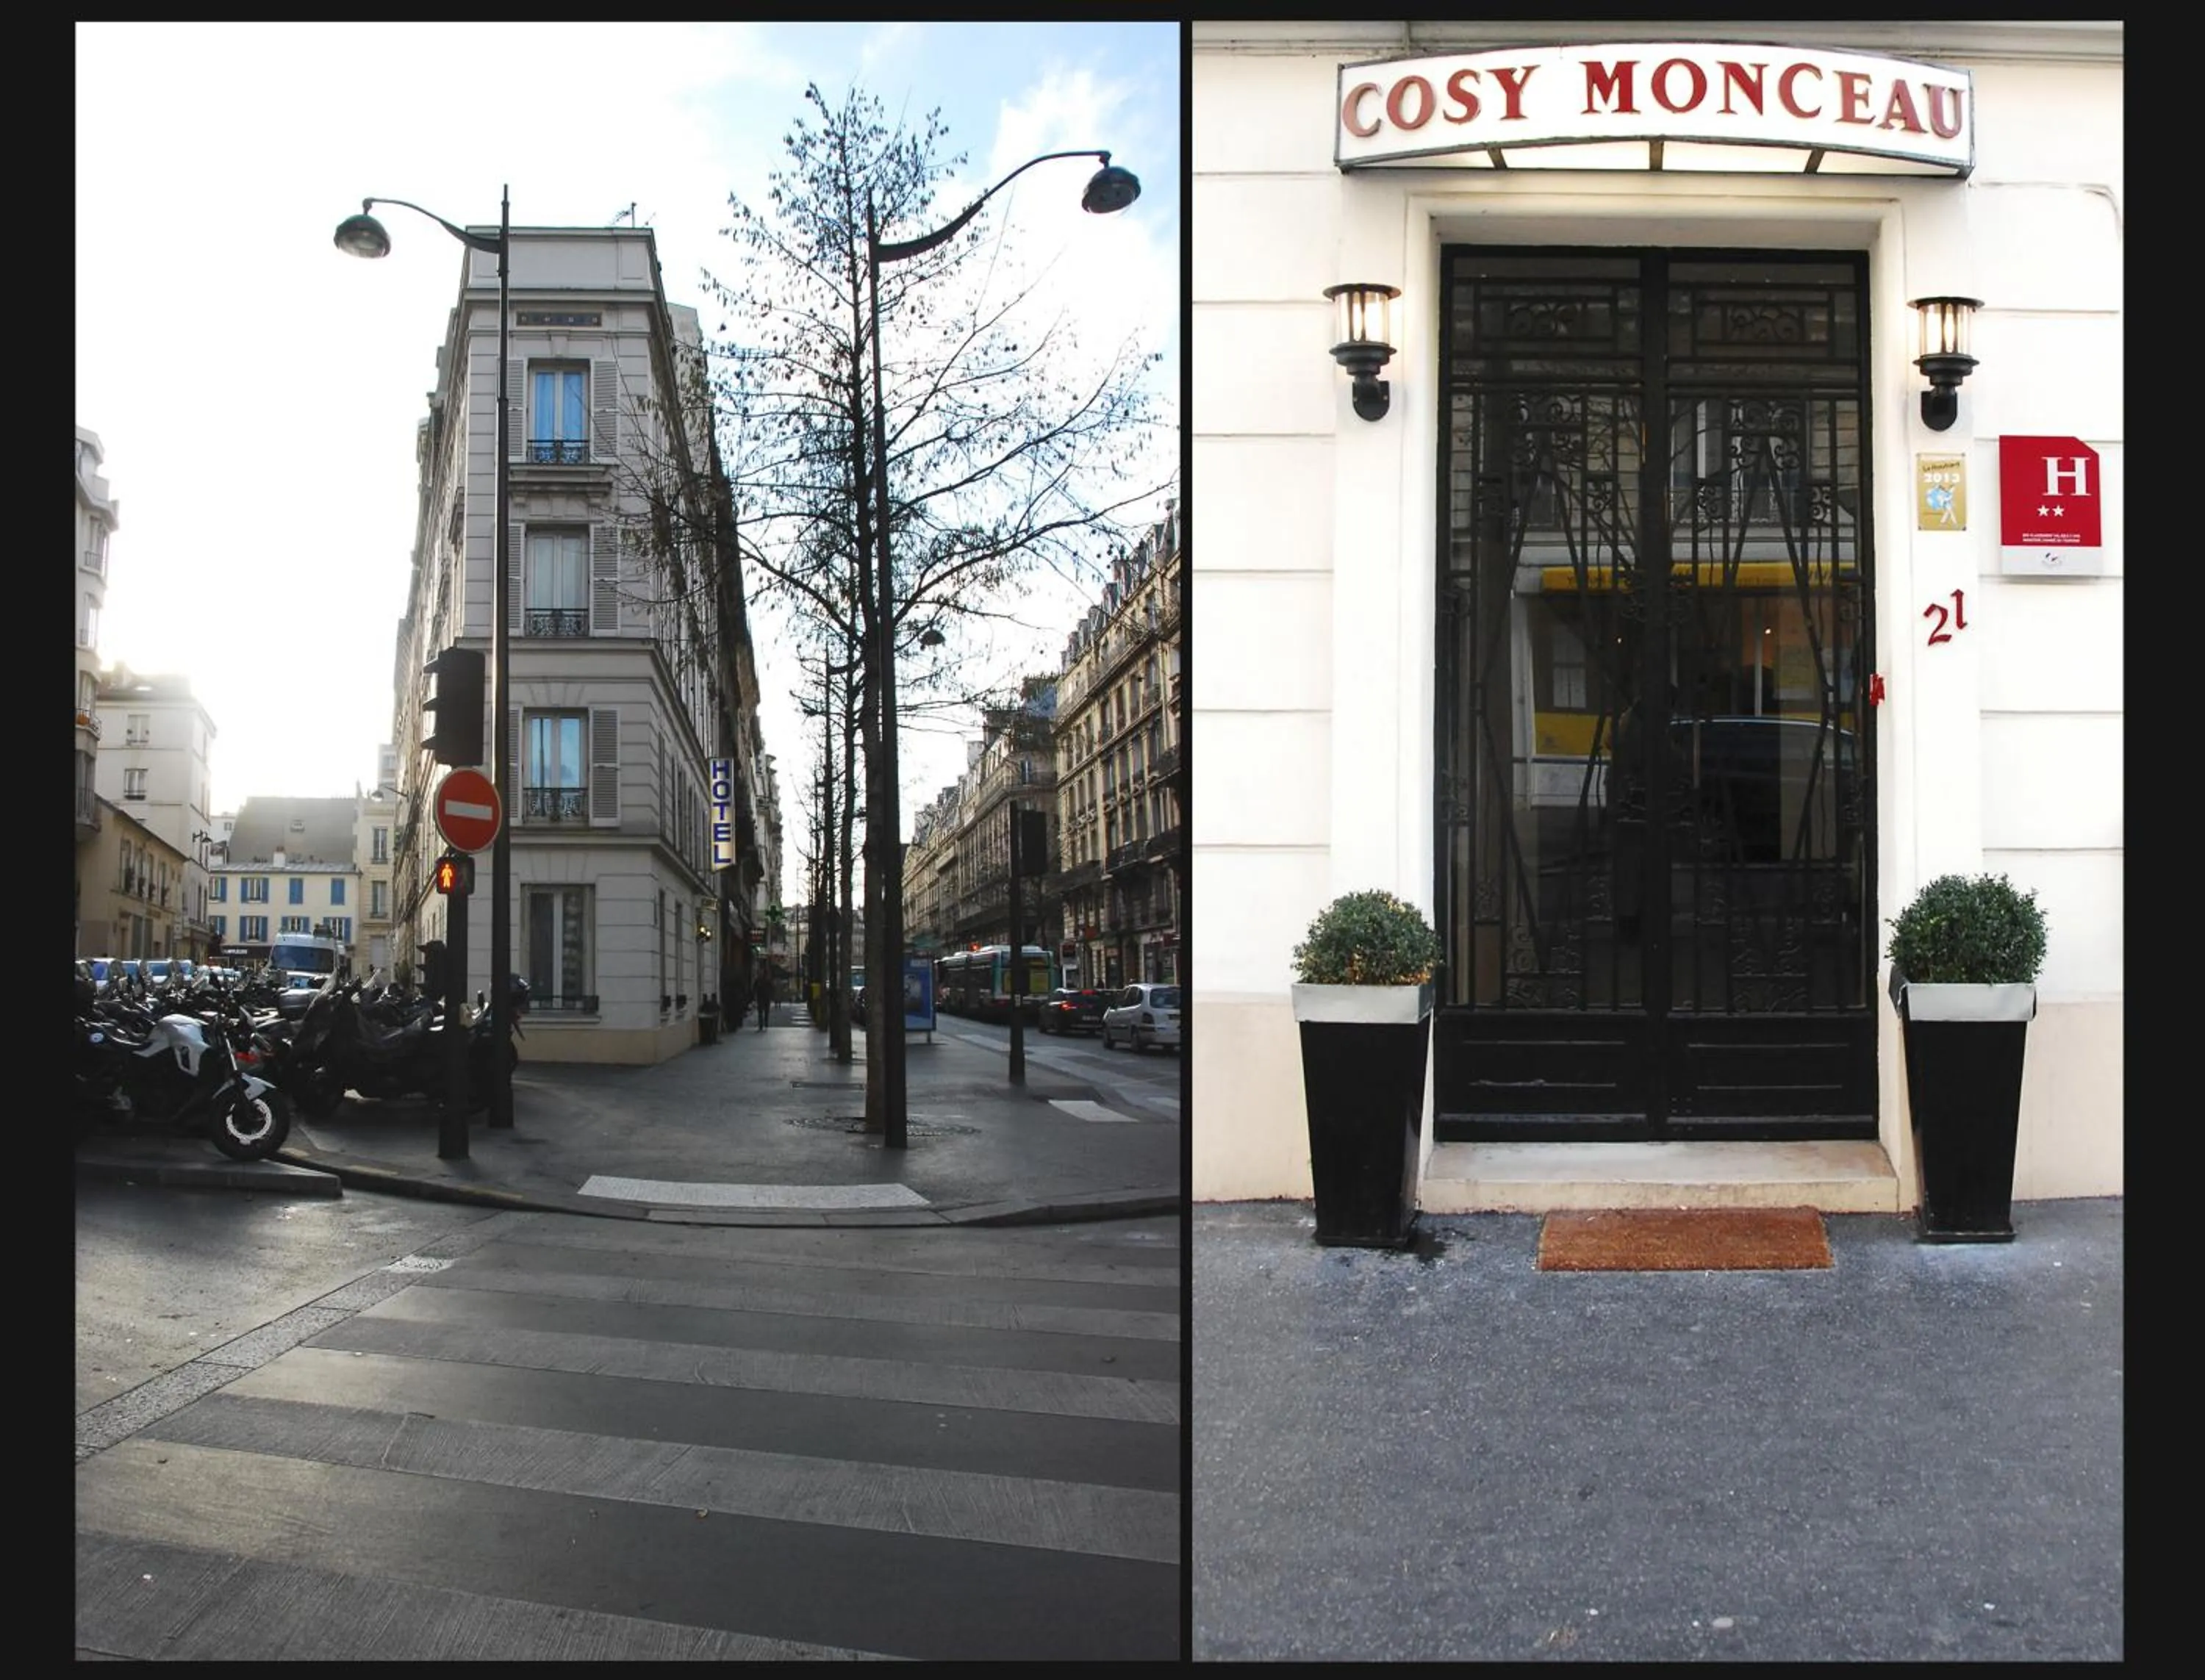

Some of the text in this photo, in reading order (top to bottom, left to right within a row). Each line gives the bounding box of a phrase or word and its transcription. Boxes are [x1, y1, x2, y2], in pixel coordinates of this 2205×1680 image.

[1341, 58, 1965, 139] COSY MONCEAU
[2043, 456, 2091, 495] H
[1923, 589, 1968, 647] 21
[712, 760, 731, 863] HOTEL
